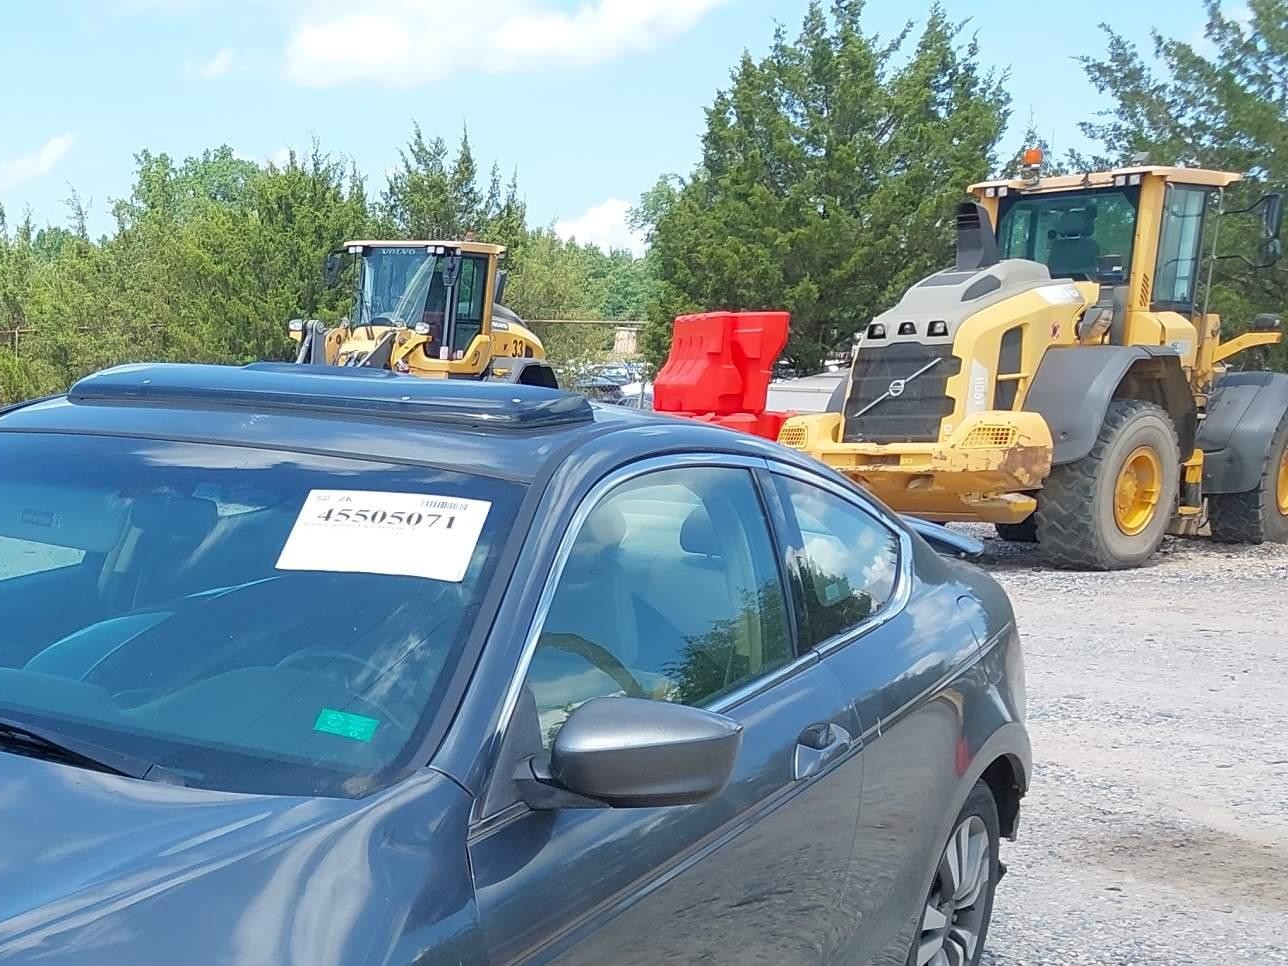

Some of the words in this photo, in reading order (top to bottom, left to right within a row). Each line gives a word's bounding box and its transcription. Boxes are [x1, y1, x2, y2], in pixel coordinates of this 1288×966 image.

[381, 247, 416, 256] VOLVO
[511, 339, 524, 358] 33
[316, 507, 457, 530] 45505071
